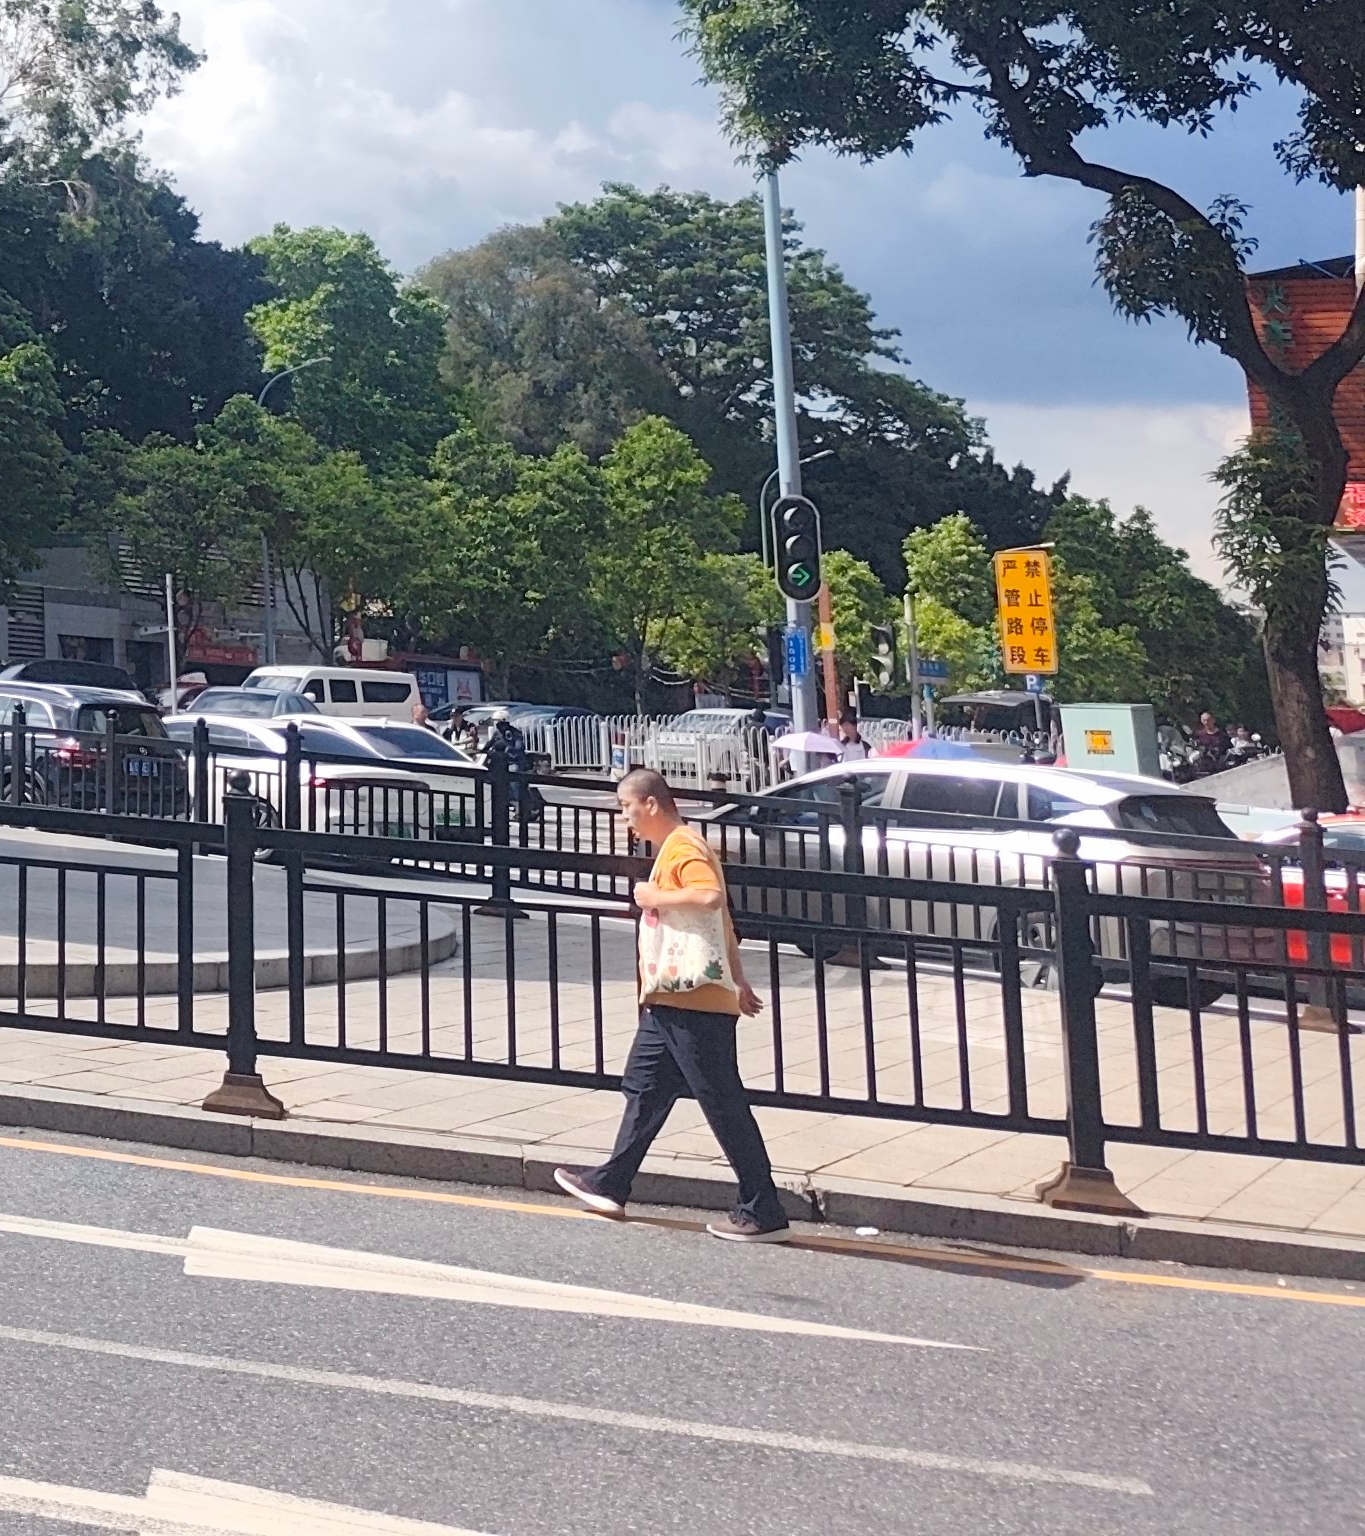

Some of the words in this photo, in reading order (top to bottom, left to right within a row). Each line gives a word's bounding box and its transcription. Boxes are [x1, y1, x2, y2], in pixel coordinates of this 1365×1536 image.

[1002, 559, 1027, 665] 严管路段
[1024, 559, 1051, 666] 禁止停车
[1025, 674, 1038, 690] P
